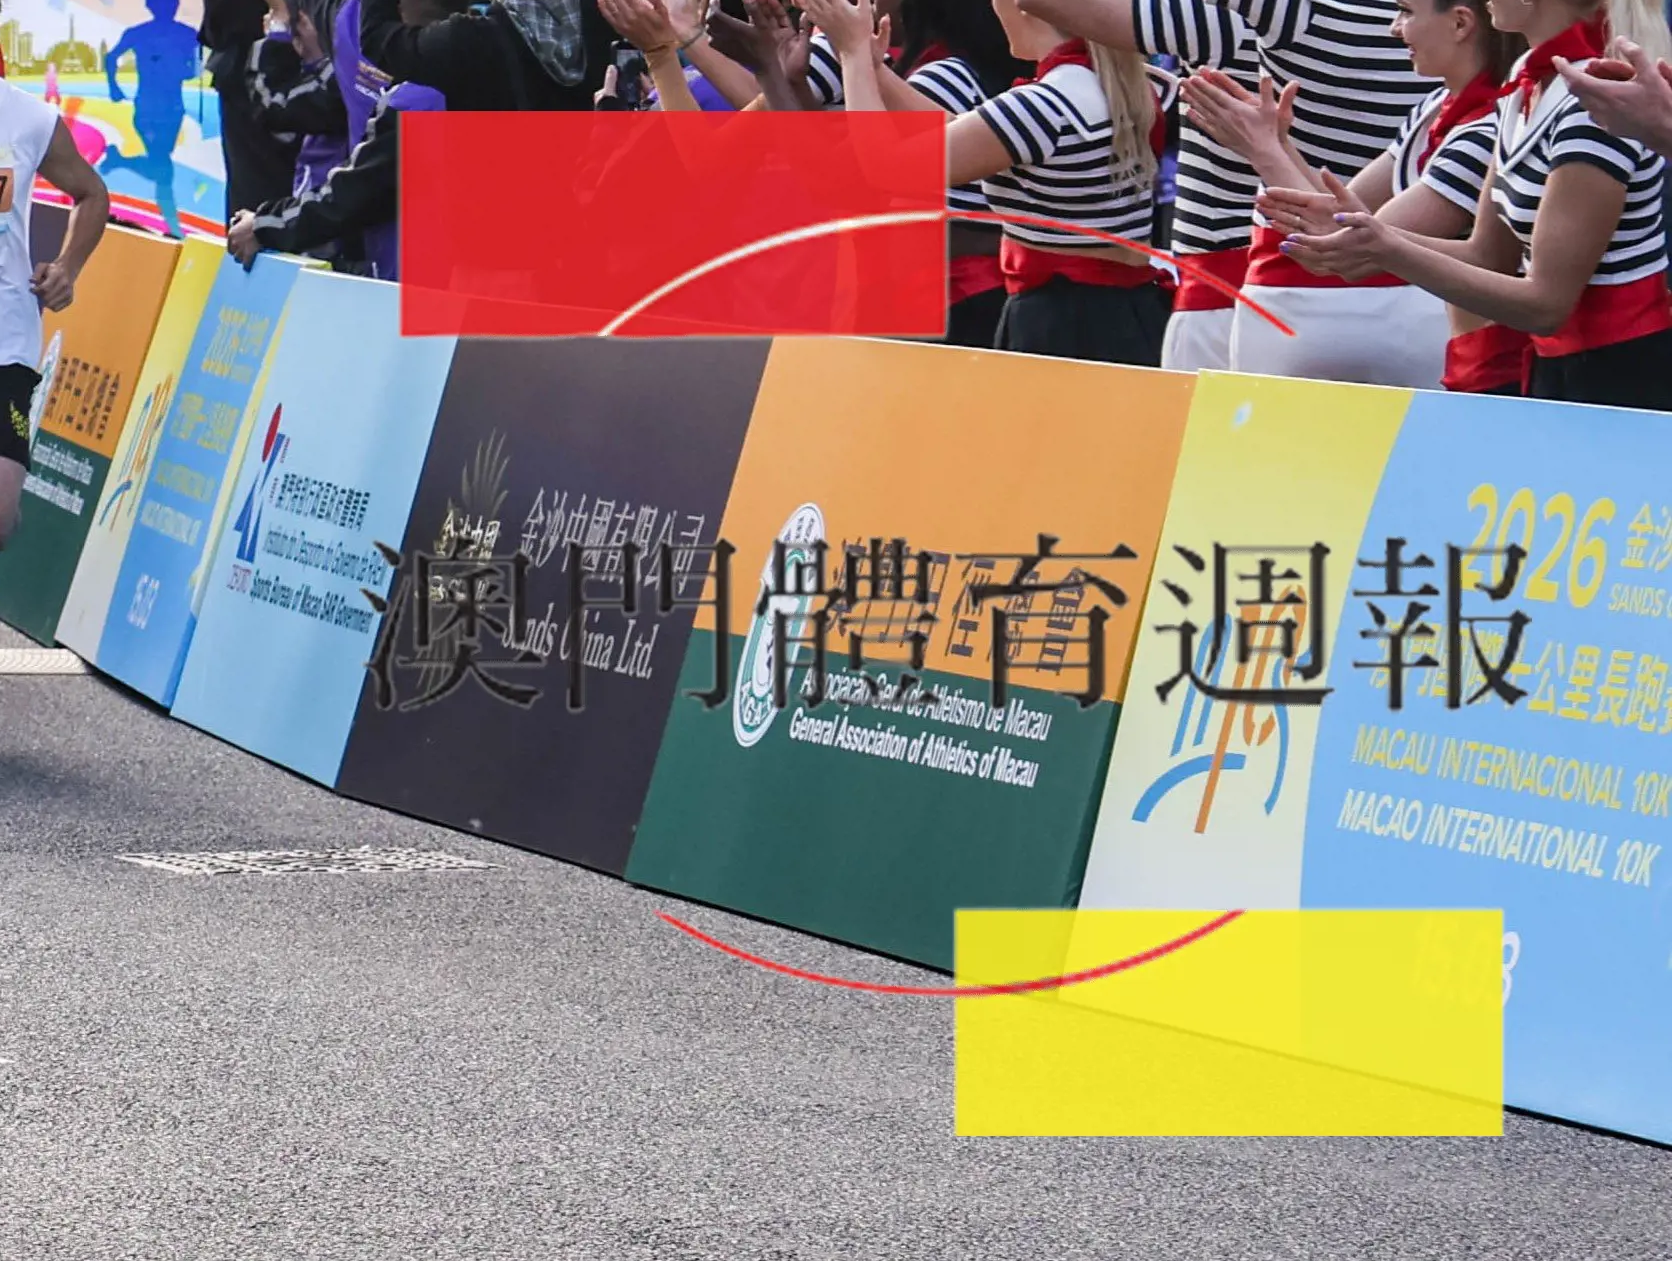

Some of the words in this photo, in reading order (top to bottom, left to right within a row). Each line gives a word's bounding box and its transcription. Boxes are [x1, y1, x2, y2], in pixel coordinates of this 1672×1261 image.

[1460, 482, 1616, 608] 2026
[1608, 583, 1665, 617] SANDS
[502, 603, 556, 657] Snds
[614, 619, 659, 680] Ltd.
[789, 707, 839, 747] General
[835, 715, 908, 761] Association
[907, 731, 926, 764] of
[921, 734, 979, 777] Athletics
[978, 746, 998, 779] of
[993, 747, 1039, 788] Macau
[1004, 698, 1052, 741] Macau
[1351, 723, 1437, 775] MACAU
[1436, 736, 1624, 811] INTERNACIONAL
[1631, 771, 1672, 818] 10K
[1336, 788, 1423, 842] MACAO
[1422, 803, 1608, 878] INTERNATIONAL
[1612, 839, 1662, 887] 10K
